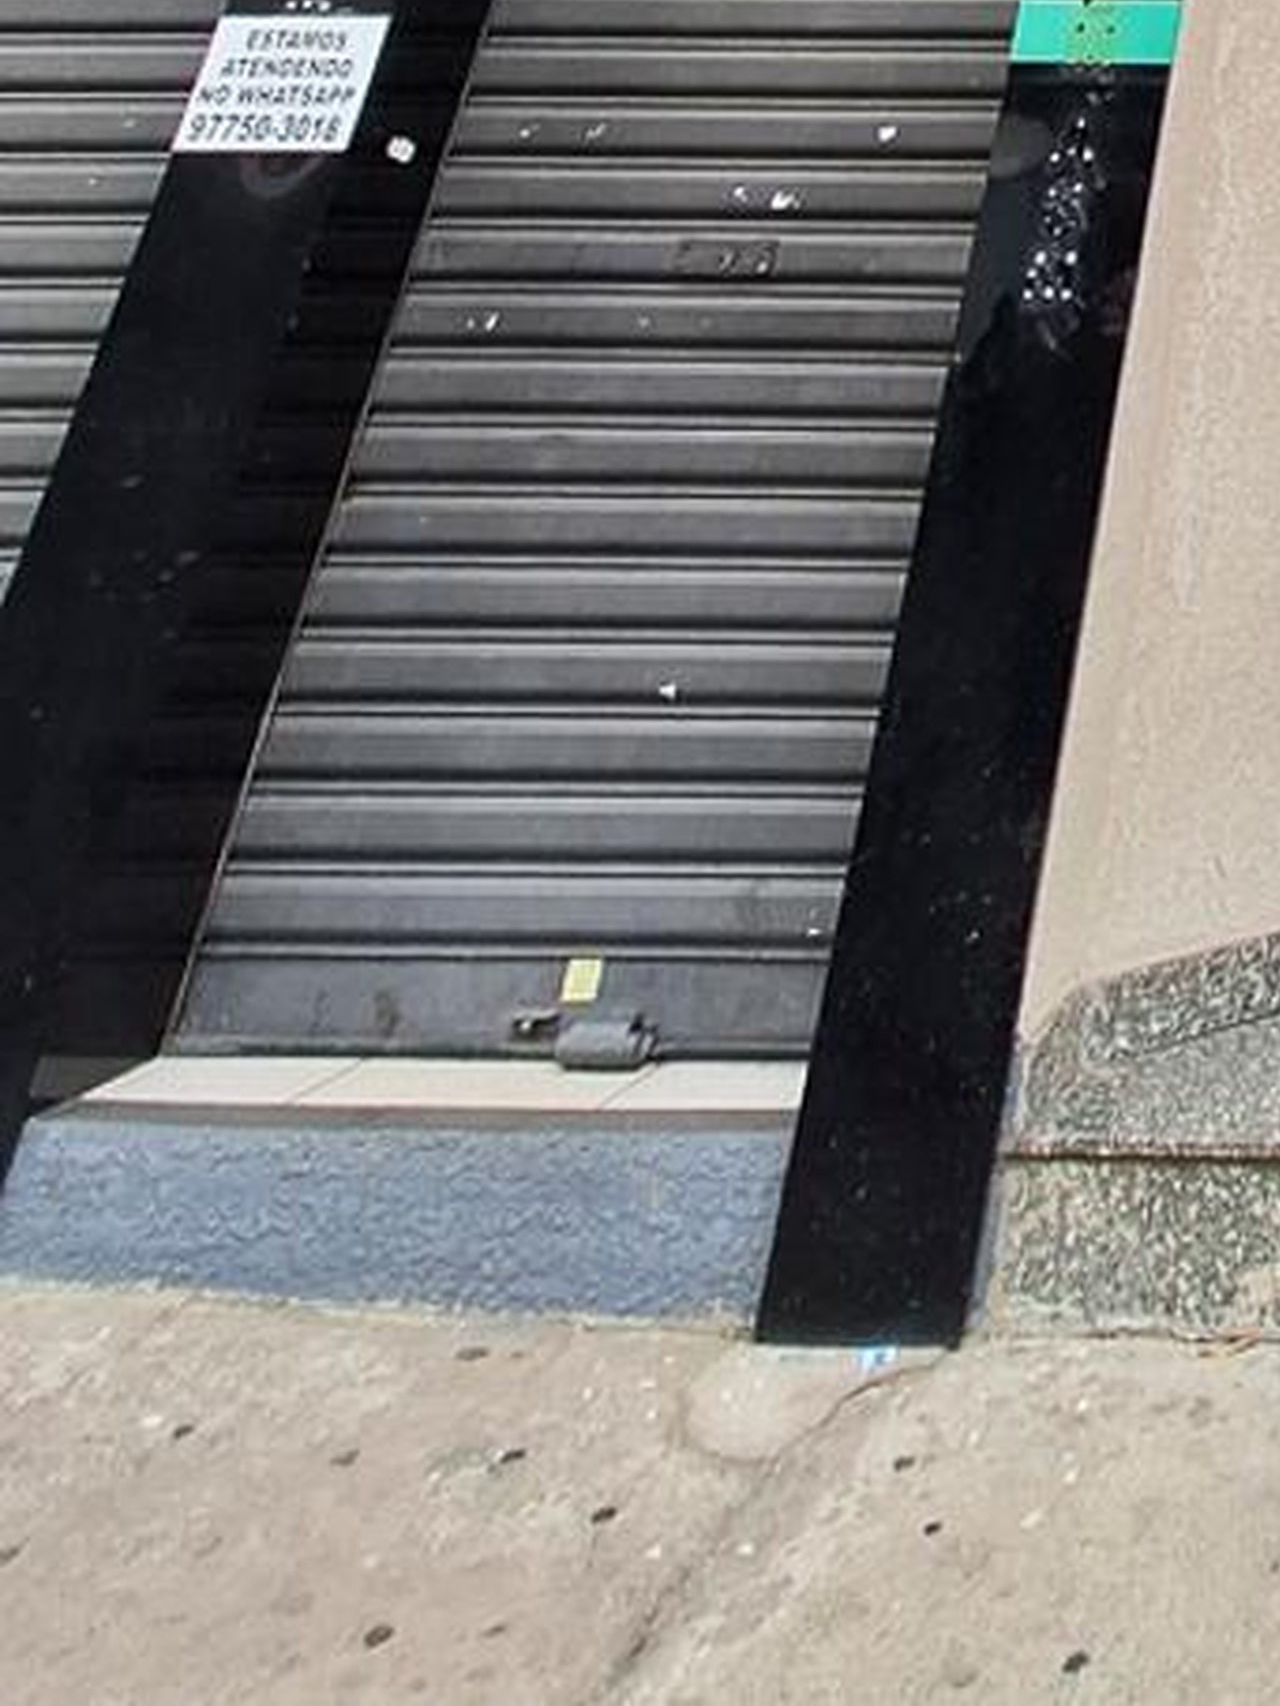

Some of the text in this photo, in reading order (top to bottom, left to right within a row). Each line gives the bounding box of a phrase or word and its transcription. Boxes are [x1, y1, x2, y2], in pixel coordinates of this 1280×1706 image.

[247, 29, 347, 51] ESTAMOS
[220, 57, 353, 78] ATENDENDO
[196, 84, 357, 106] NO WHATSAPP
